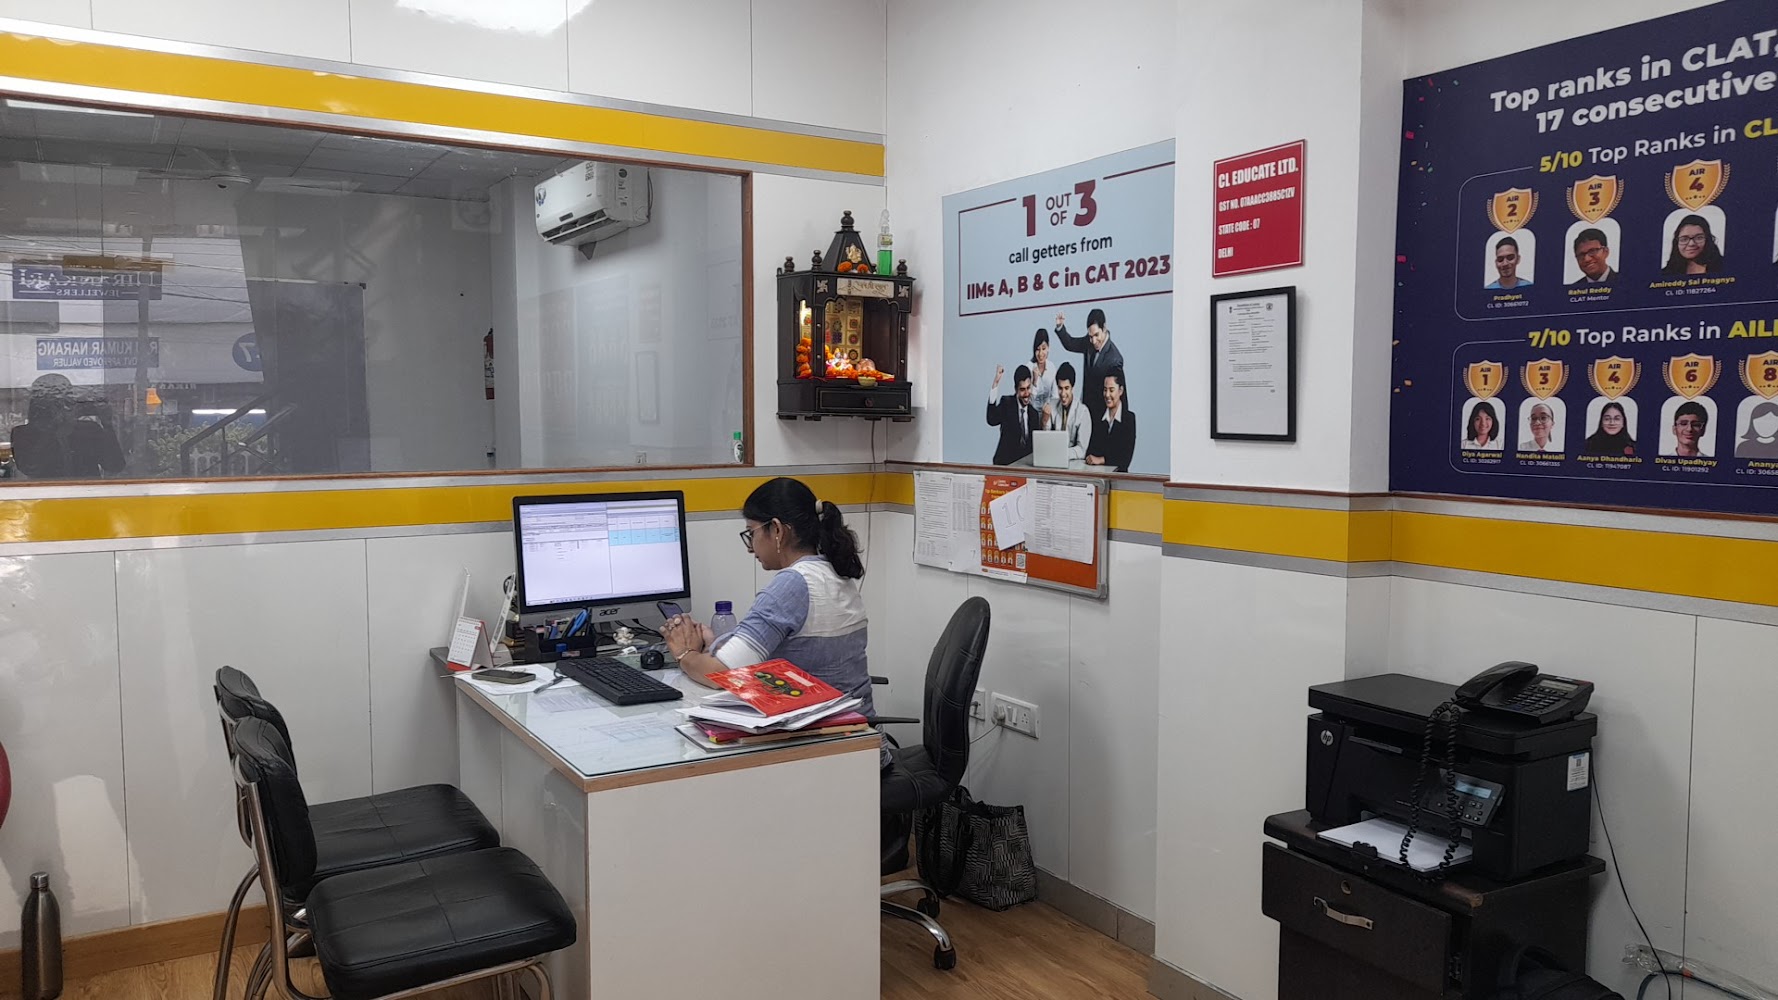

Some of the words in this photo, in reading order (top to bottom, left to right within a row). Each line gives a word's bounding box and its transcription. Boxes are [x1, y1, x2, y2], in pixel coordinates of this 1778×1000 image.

[1490, 86, 1540, 112] Top
[1547, 66, 1632, 101] ranks
[1641, 55, 1671, 81] in
[1536, 109, 1565, 134] 17
[1572, 71, 1777, 126] consecutive
[1540, 150, 1583, 172] 5/10
[1588, 145, 1628, 164] Top
[1635, 130, 1706, 156] Ranks
[1713, 125, 1736, 144] in
[1218, 173, 1230, 188] CL
[1232, 162, 1276, 186] EDUCATE
[1278, 157, 1299, 176] LTD.
[1688, 168, 1706, 177] AIR
[1588, 182, 1603, 191] AIR
[1689, 177, 1704, 192] 4
[1046, 192, 1072, 210] OUT
[1073, 179, 1098, 227] 3
[1506, 194, 1520, 203] AIR
[1589, 192, 1600, 206] 3
[1022, 194, 1036, 236] 1
[1507, 203, 1517, 216] 2
[1050, 210, 1068, 226] OF
[1218, 222, 1234, 235] STATE
[1234, 220, 1250, 232] CODE
[1008, 247, 1029, 264] call
[1032, 240, 1077, 264] getters
[1080, 236, 1112, 254] from
[967, 284, 994, 300] IIMs
[998, 279, 1013, 298] A,
[1018, 276, 1028, 293] B
[1033, 274, 1043, 290] &
[1048, 271, 1060, 289] C
[1064, 267, 1080, 287] in
[1085, 262, 1120, 284] CAT
[1124, 254, 1171, 279] 2023
[1649, 280, 1686, 288] Amireddy
[1702, 276, 1735, 285] Pragnya
[1589, 286, 1612, 294] Reddy
[1528, 328, 1571, 348] 7/10
[1576, 328, 1615, 347] Top
[1622, 323, 1692, 343] Ranks
[1699, 321, 1720, 339] in
[1482, 374, 1489, 386] 1
[1539, 372, 1550, 385] 3
[1608, 371, 1620, 384] 4
[1685, 369, 1698, 383] 6
[1763, 367, 1777, 381] 8
[1678, 458, 1717, 467] Upadhyay
[599, 607, 621, 616] acer
